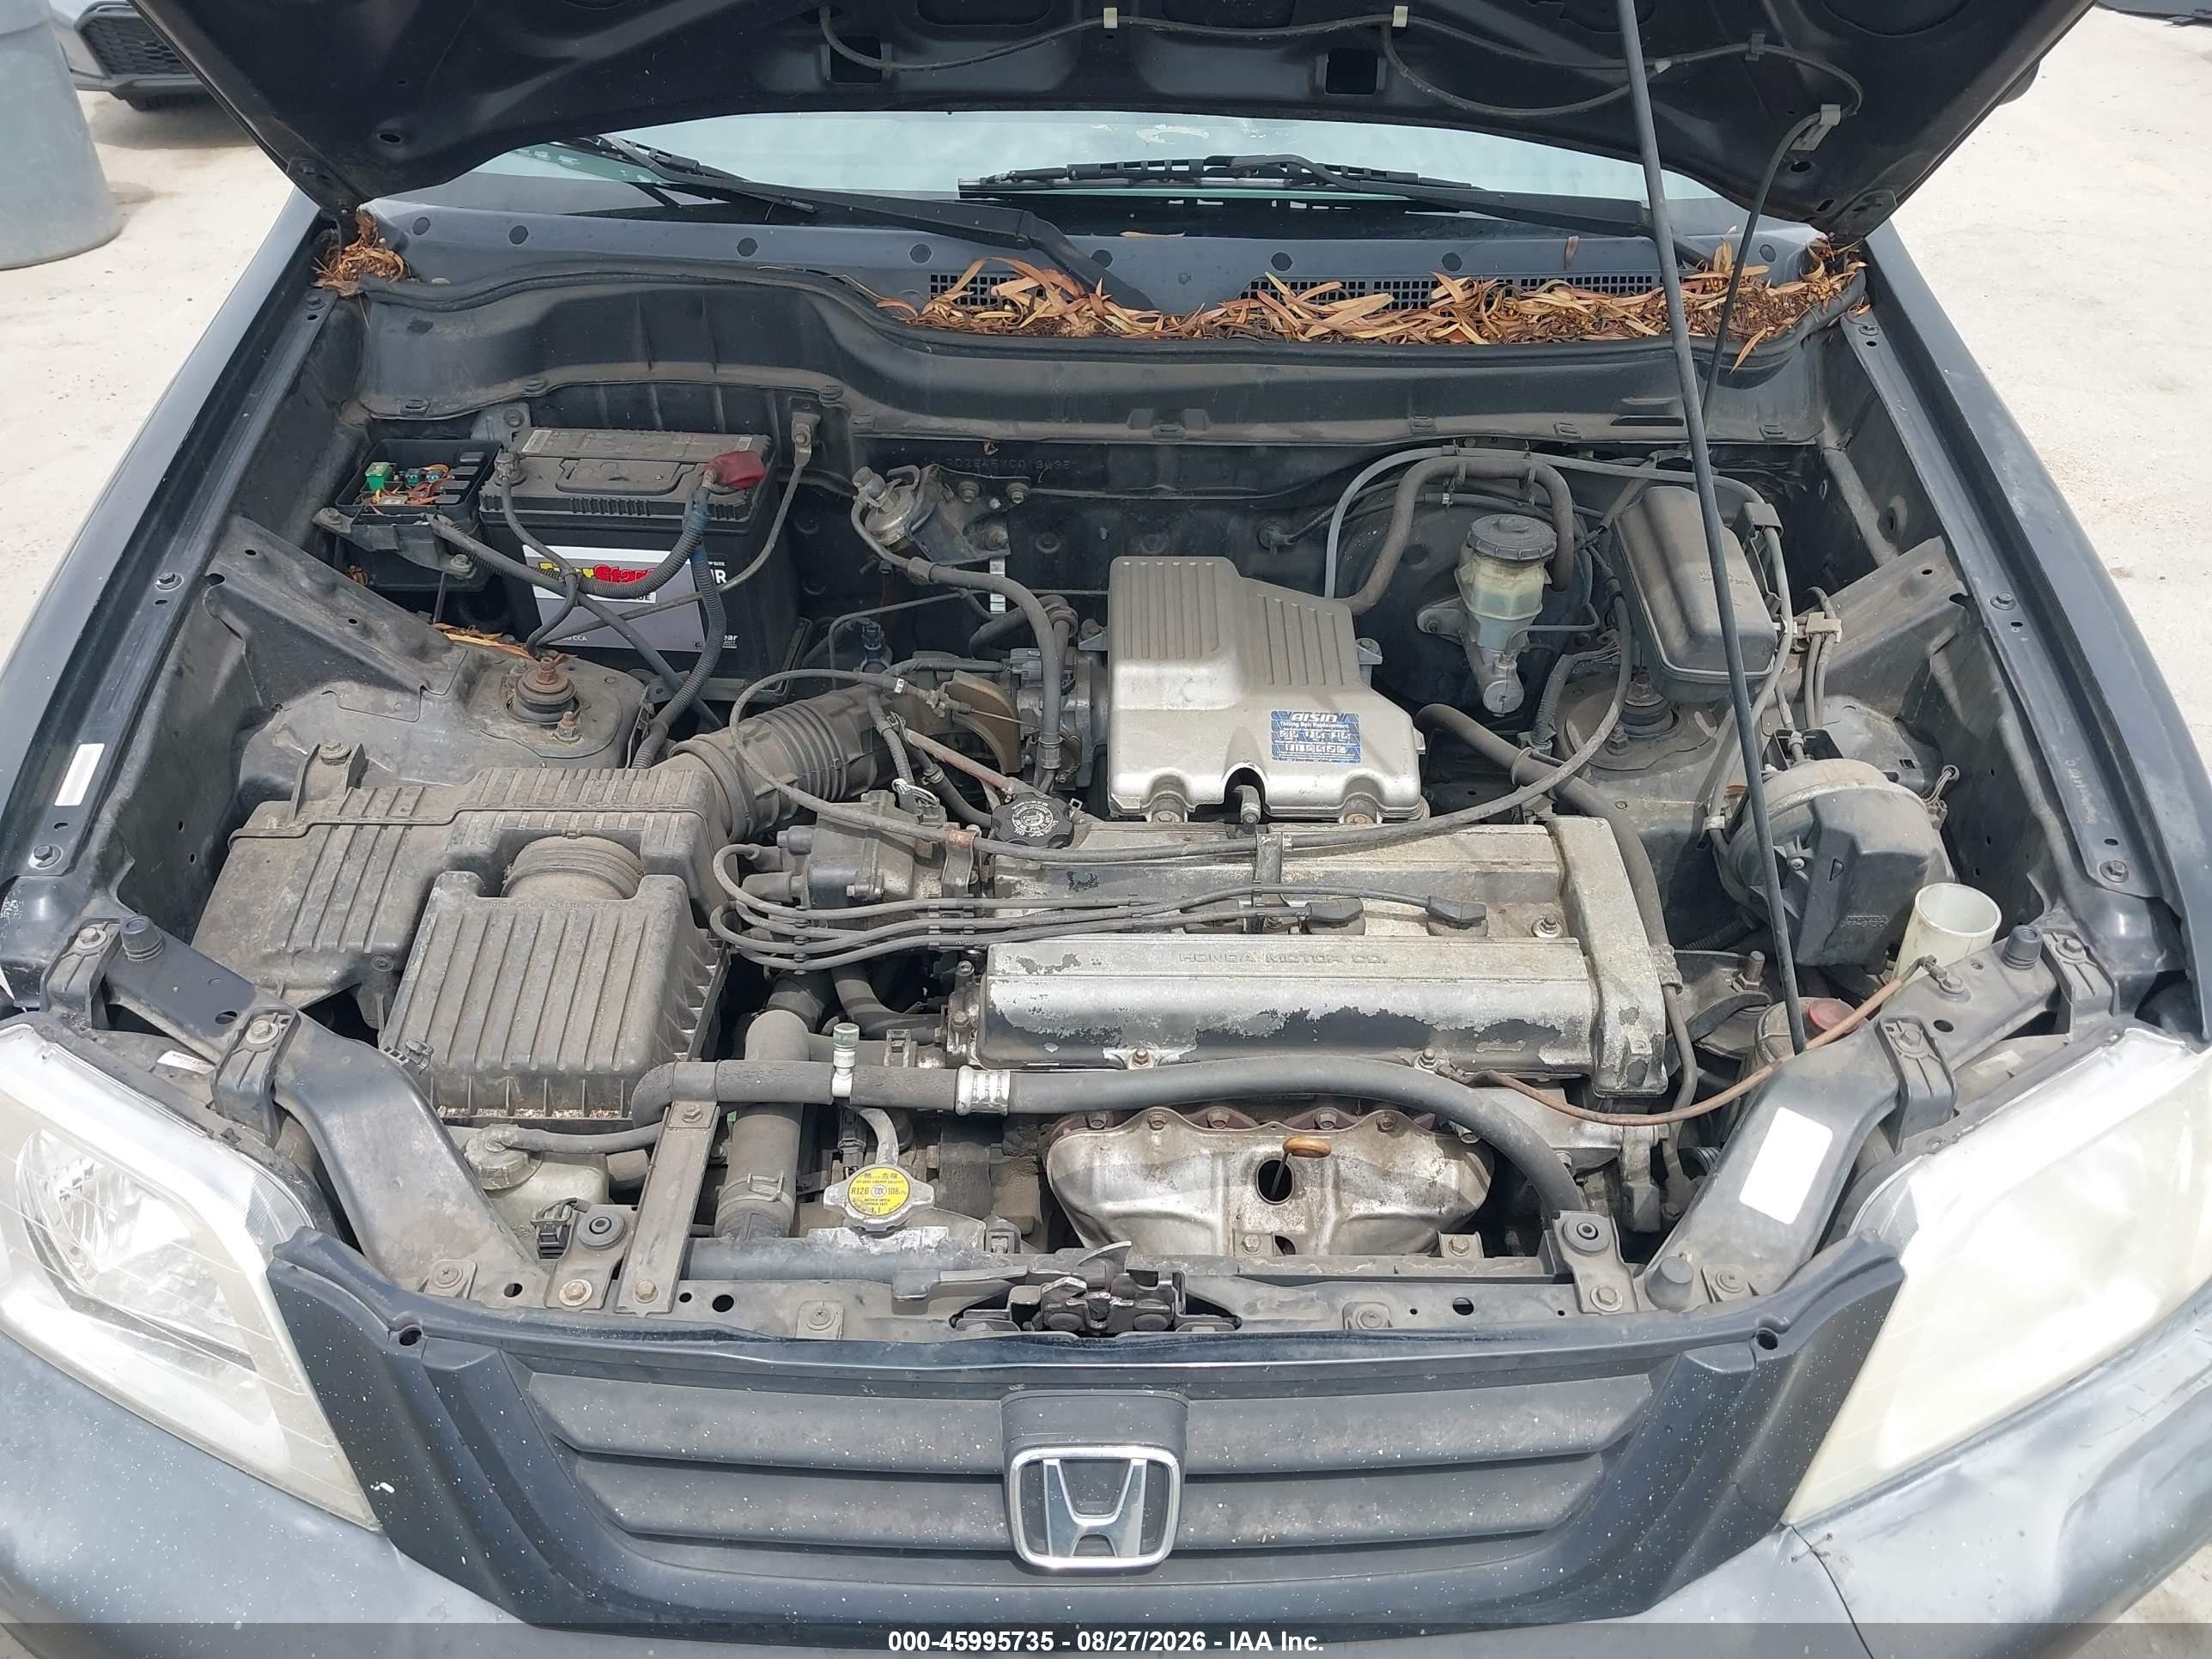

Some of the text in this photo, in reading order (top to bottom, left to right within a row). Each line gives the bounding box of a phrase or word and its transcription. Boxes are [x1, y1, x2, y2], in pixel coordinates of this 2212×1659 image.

[1179, 953, 1256, 963] HONDA
[1266, 953, 1342, 963] MOTOR
[851, 1187, 869, 1195] R126
